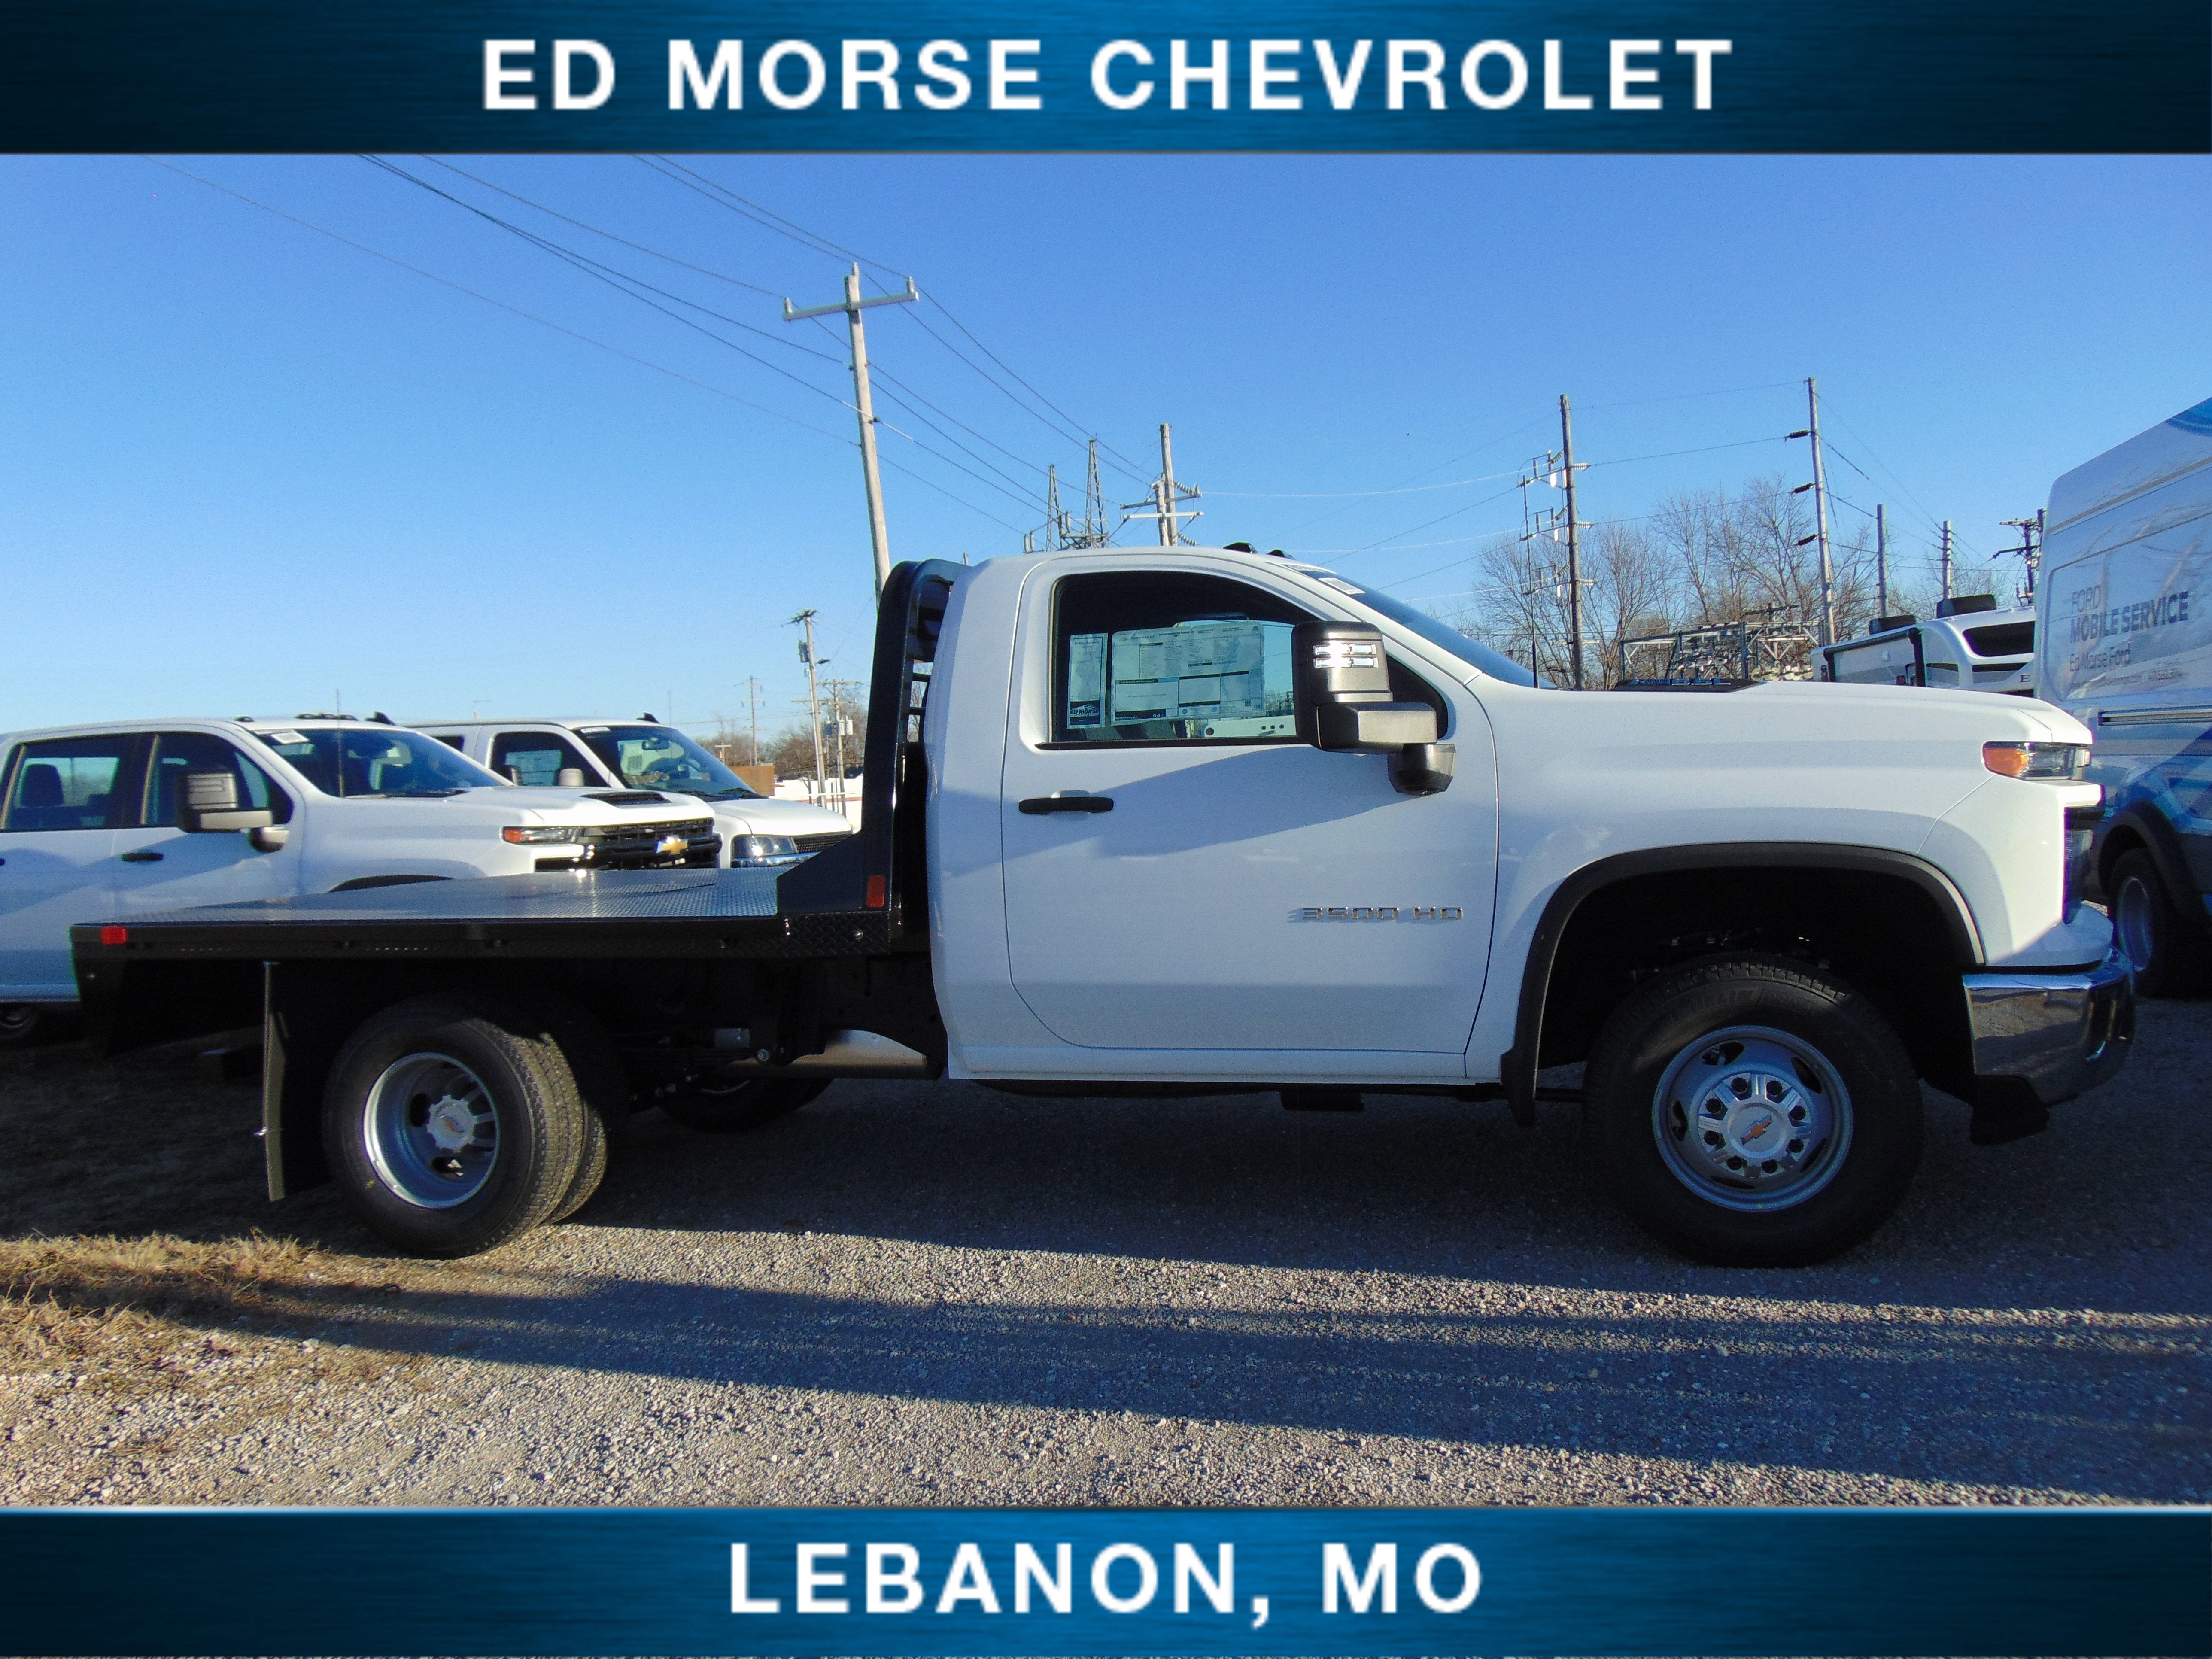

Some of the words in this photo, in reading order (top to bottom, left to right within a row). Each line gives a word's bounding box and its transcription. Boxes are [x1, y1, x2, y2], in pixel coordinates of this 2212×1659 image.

[2071, 585, 2101, 614] FORD
[2070, 608, 2119, 643] MOBILE
[2121, 591, 2188, 633] SERVICE
[2109, 644, 2130, 666] Ford
[1303, 907, 1399, 920] 3500
[1413, 906, 1463, 920] HD
